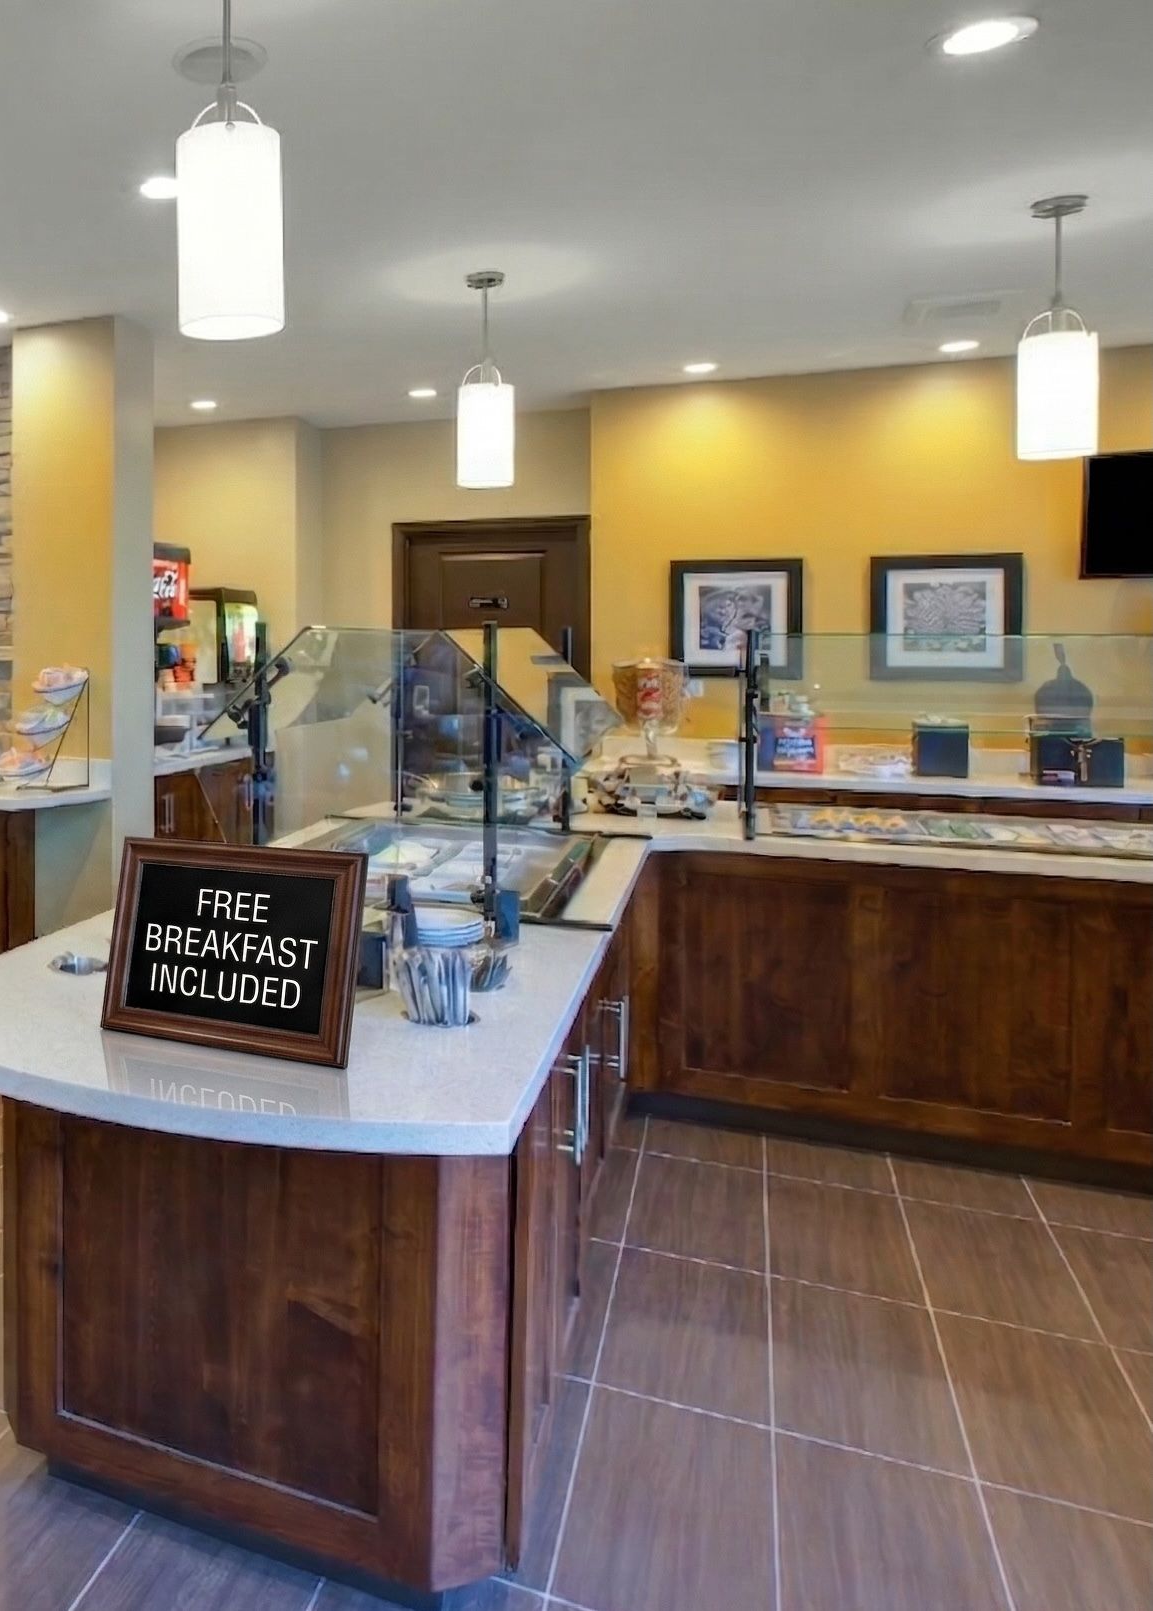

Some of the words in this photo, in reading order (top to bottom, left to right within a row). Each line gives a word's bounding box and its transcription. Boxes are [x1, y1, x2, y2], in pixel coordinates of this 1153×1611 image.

[197, 888, 271, 923] FREE
[145, 923, 319, 970] BREAKFAST
[150, 963, 301, 1009] INCLUDED
